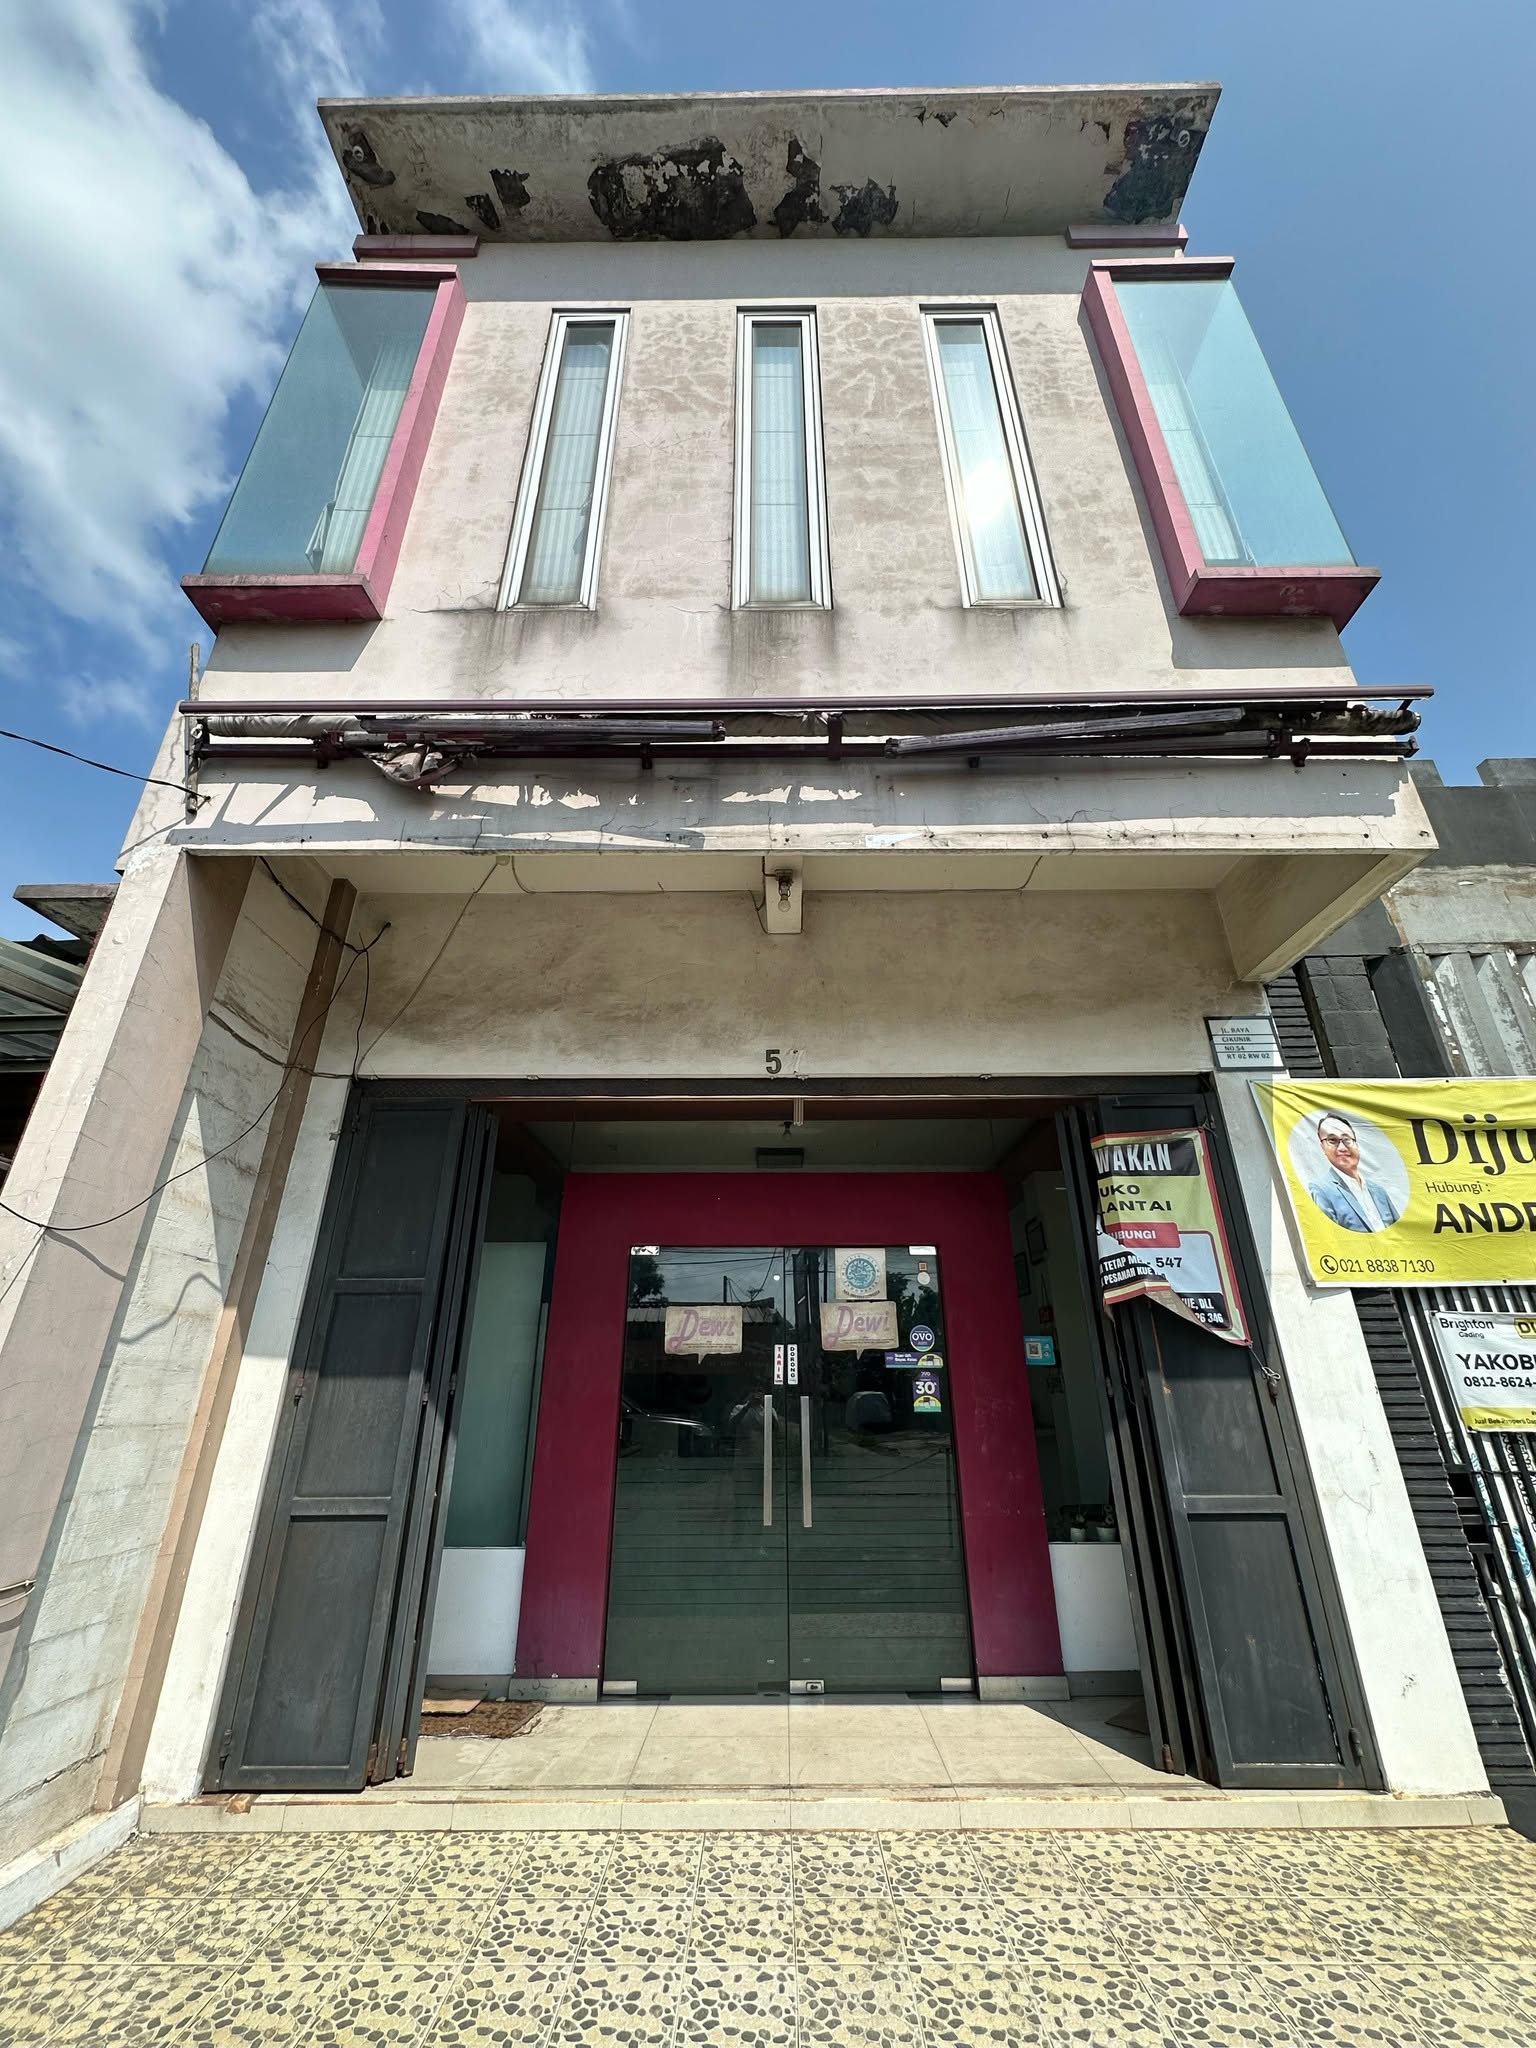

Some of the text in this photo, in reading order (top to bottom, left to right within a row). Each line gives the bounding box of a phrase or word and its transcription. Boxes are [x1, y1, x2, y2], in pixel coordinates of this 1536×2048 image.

[1425, 1181, 1483, 1195] Hubungi
[1103, 1256, 1127, 1272] TETAP
[1155, 1257, 1182, 1268] 547
[1340, 1259, 1435, 1273] 021 8838 7130
[1103, 1267, 1136, 1285] PESANAN
[1198, 1297, 1214, 1309] DLL
[1207, 1312, 1224, 1323] 346
[1440, 1318, 1495, 1331] Brighton
[668, 1308, 735, 1351] Dewi
[824, 1305, 889, 1347] Dewi
[912, 1333, 932, 1341] OVO
[1456, 1353, 1536, 1370] YAKOB
